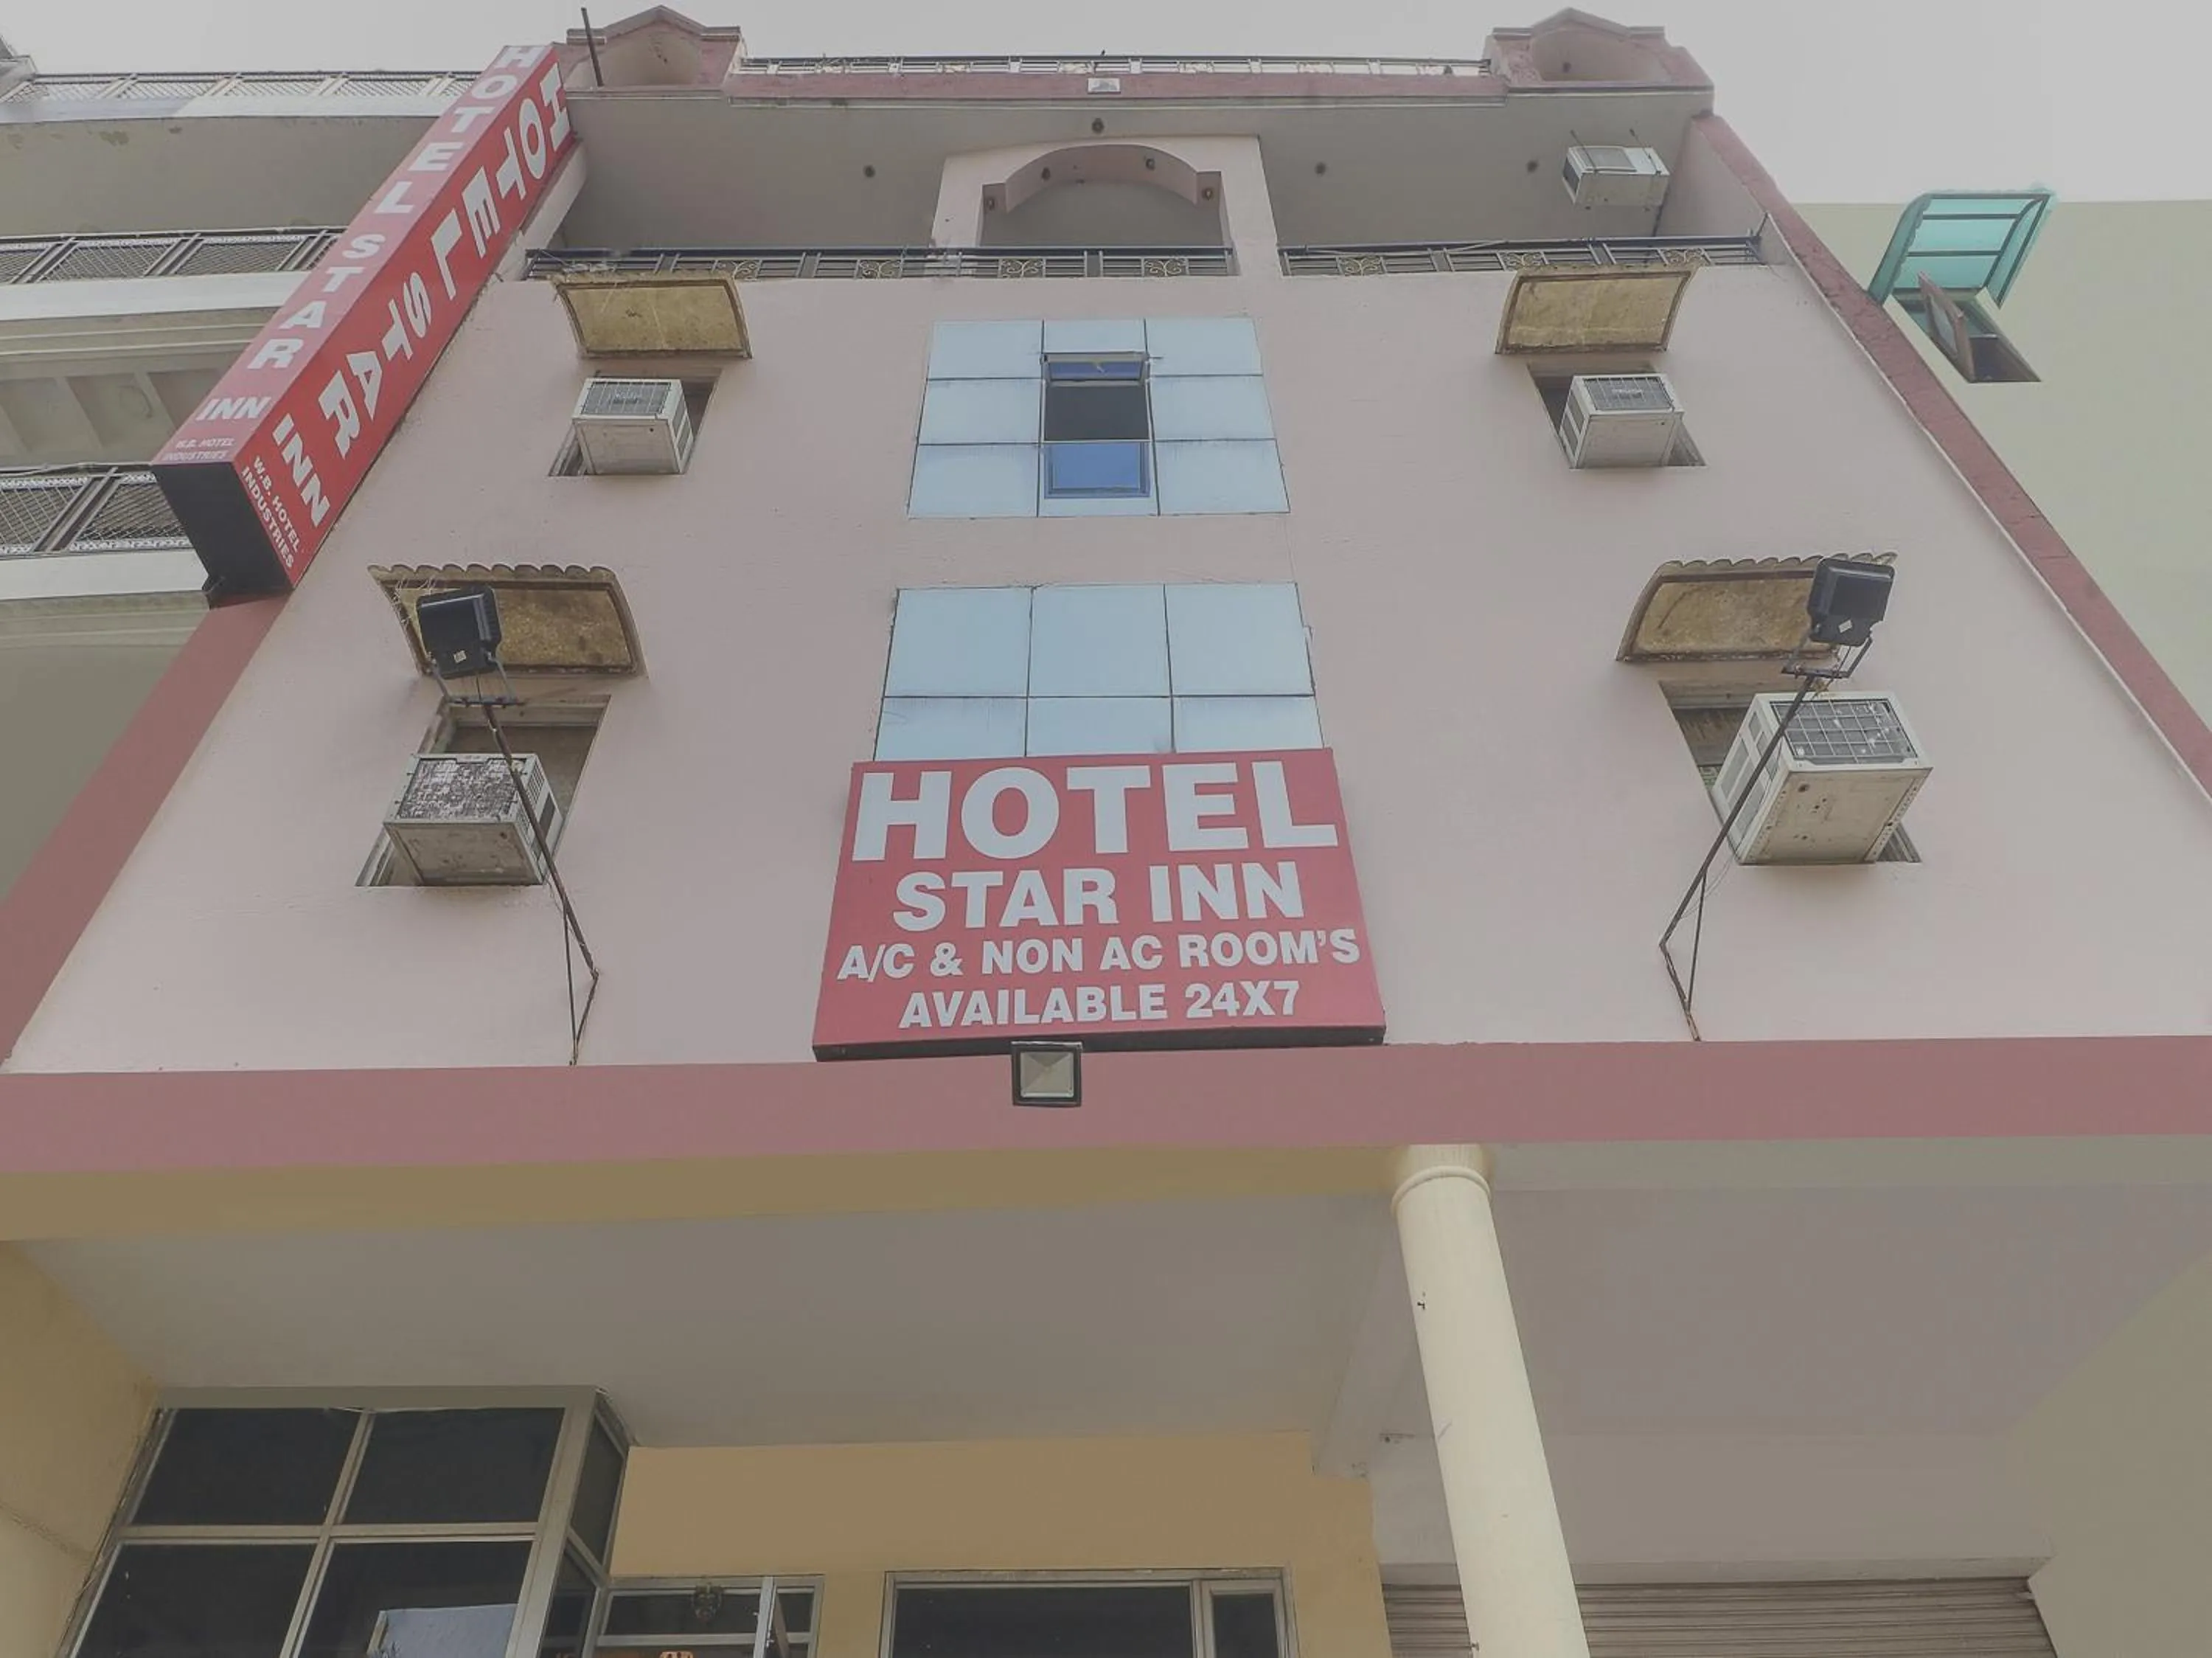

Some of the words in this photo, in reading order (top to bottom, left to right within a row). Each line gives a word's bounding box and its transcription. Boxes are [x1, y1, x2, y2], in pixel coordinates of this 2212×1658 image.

[374, 46, 535, 214] HOTEL
[430, 62, 571, 301] HOTEL
[248, 234, 386, 370] STAR
[195, 397, 271, 421] INN
[319, 271, 432, 459] STAR
[163, 450, 229, 462] INDUSTRIES
[199, 437, 236, 447] HOTEL
[272, 413, 331, 527] INN
[241, 466, 294, 568] INDUSTRIES
[254, 455, 273, 496] W.B.
[272, 495, 300, 552] HOTEL
[852, 760, 1338, 861] HOTEL
[893, 867, 1119, 932] STAR
[1150, 861, 1304, 923] INN
[837, 943, 914, 982] A/C
[929, 941, 963, 977] &
[981, 937, 1084, 974] NON
[1099, 934, 1162, 971] AC
[1178, 928, 1360, 967] ROOM'S
[899, 985, 1168, 1029] AVAILABLE
[1186, 980, 1300, 1019] 24X7
